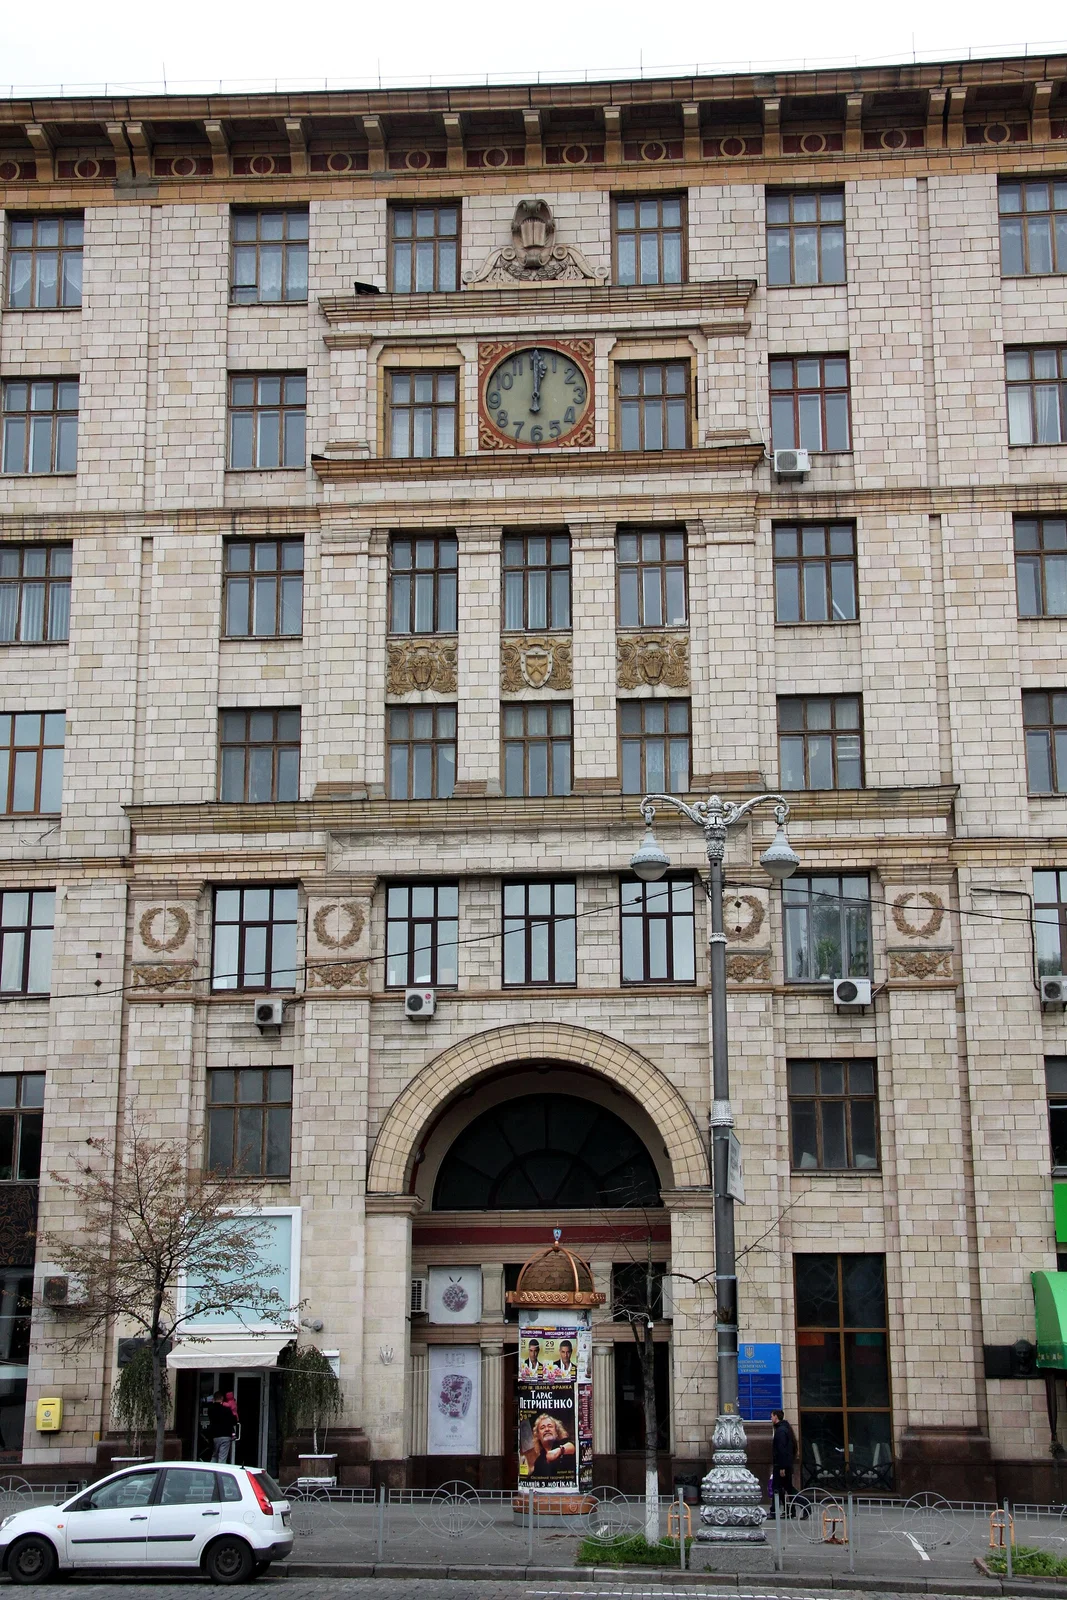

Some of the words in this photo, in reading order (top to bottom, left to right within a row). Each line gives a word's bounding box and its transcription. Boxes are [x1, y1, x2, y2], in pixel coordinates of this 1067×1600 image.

[512, 357, 523, 376] 11
[552, 357, 557, 373] 1
[496, 372, 513, 390] 10
[564, 368, 576, 384] 2
[488, 391, 501, 409] 9
[573, 387, 585, 404] 3
[497, 410, 508, 428] 8
[564, 406, 576, 425] 4
[513, 421, 525, 439] 7
[531, 424, 543, 442] 6
[549, 420, 561, 438] 5
[519, 1397, 573, 1409] ПЕТРИНЕНКО
[531, 1390, 553, 1399] ТАРАС
